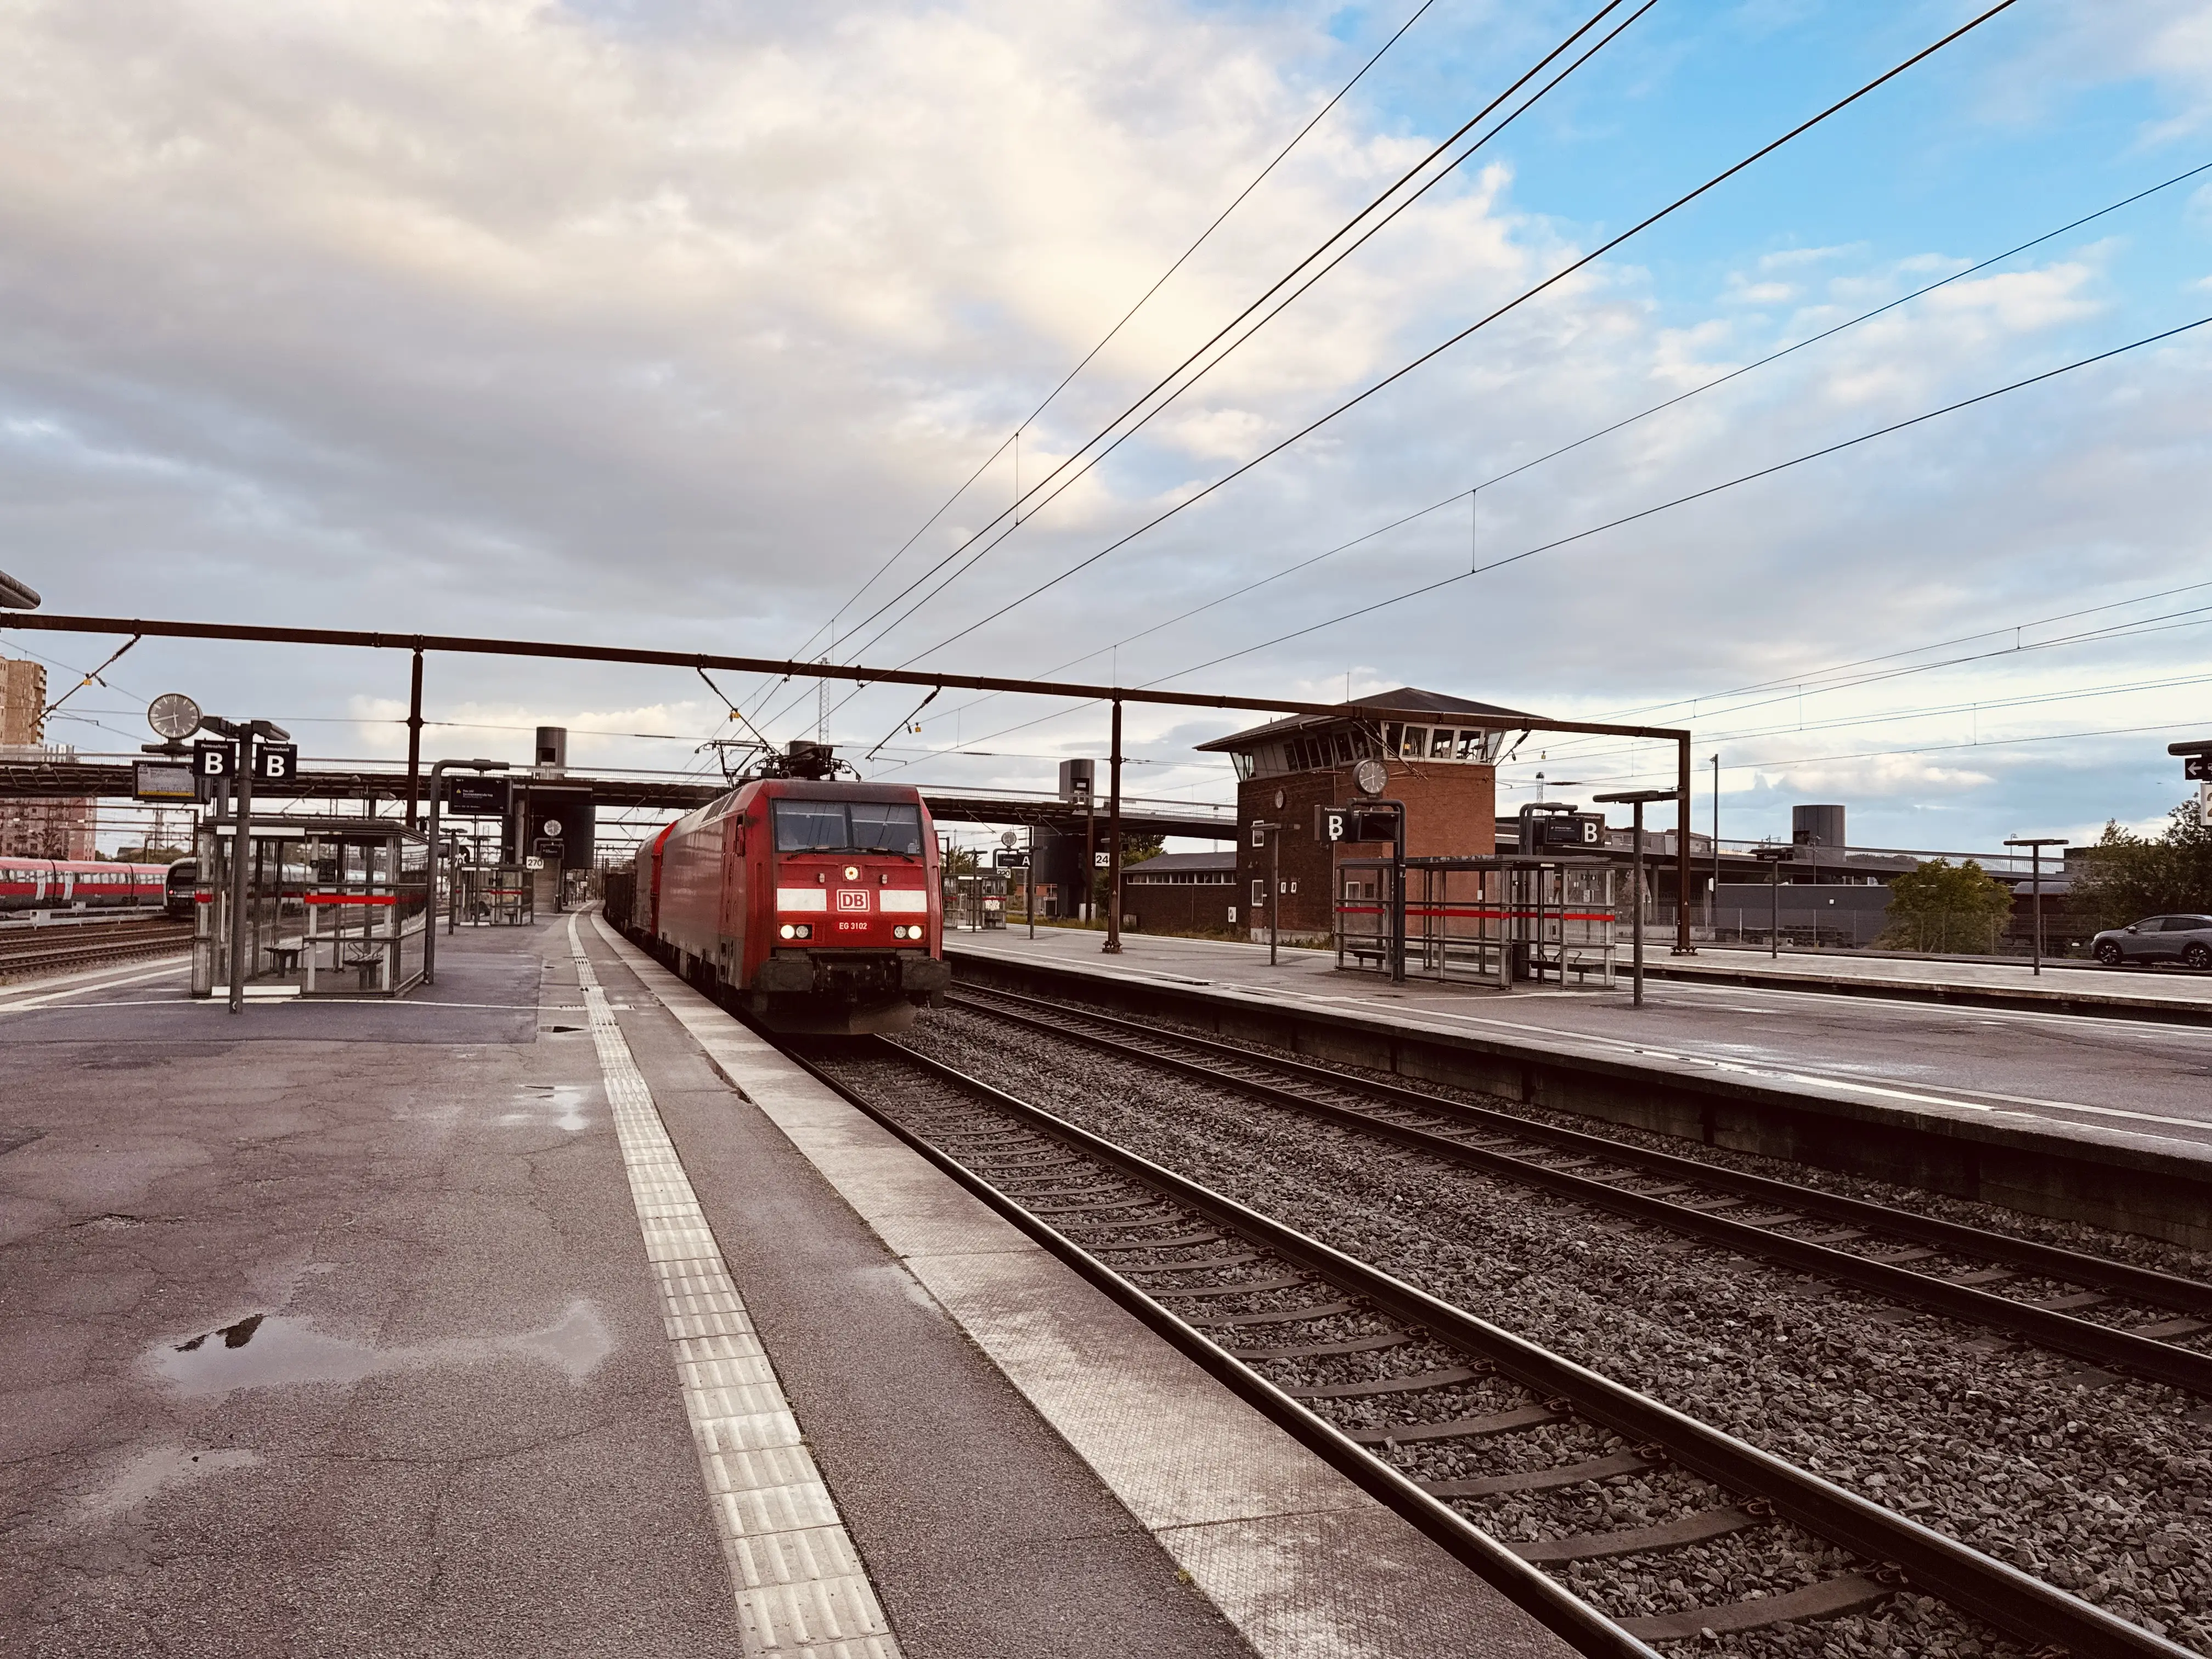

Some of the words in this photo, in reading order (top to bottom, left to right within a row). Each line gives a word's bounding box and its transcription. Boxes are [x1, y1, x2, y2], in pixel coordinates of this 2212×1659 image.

[205, 752, 223, 775] B
[267, 755, 285, 777] B
[1329, 815, 1343, 837] B
[1584, 822, 1598, 843] B
[1022, 856, 1030, 866] A
[1096, 855, 1109, 864] 24
[843, 894, 864, 906] DB
